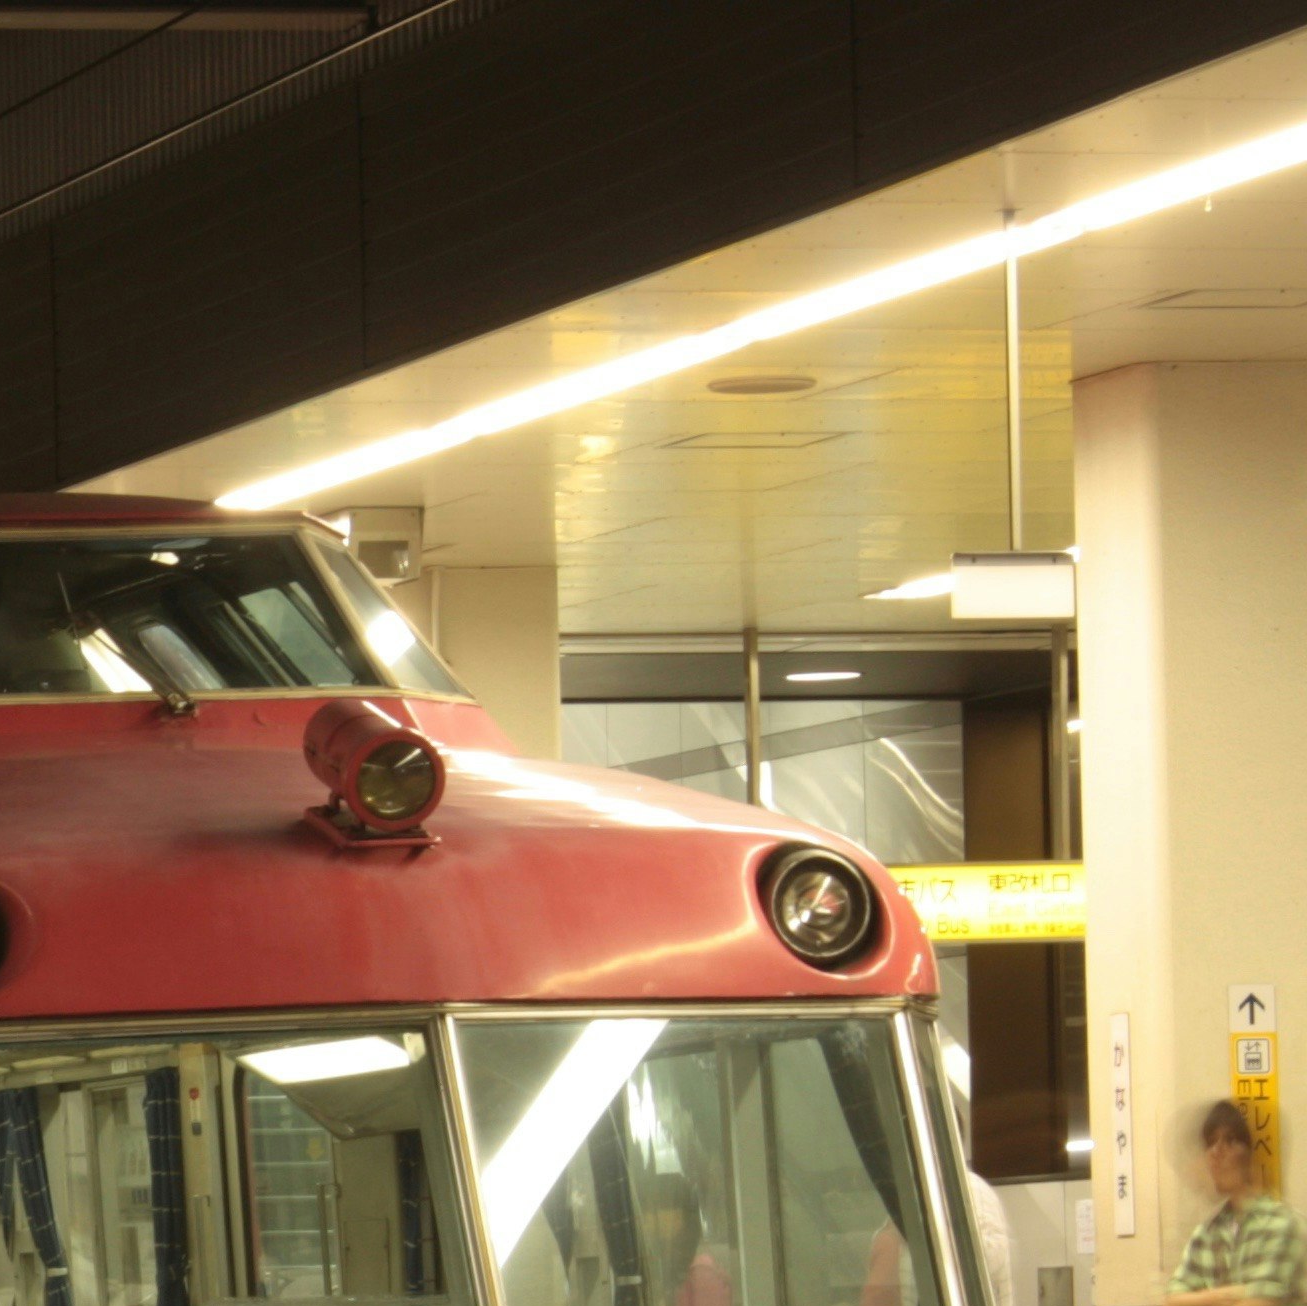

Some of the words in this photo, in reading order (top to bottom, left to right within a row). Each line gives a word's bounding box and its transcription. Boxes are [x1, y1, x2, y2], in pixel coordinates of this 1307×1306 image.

[988, 873, 1071, 894] 東改札口
[937, 916, 970, 934] Bus
